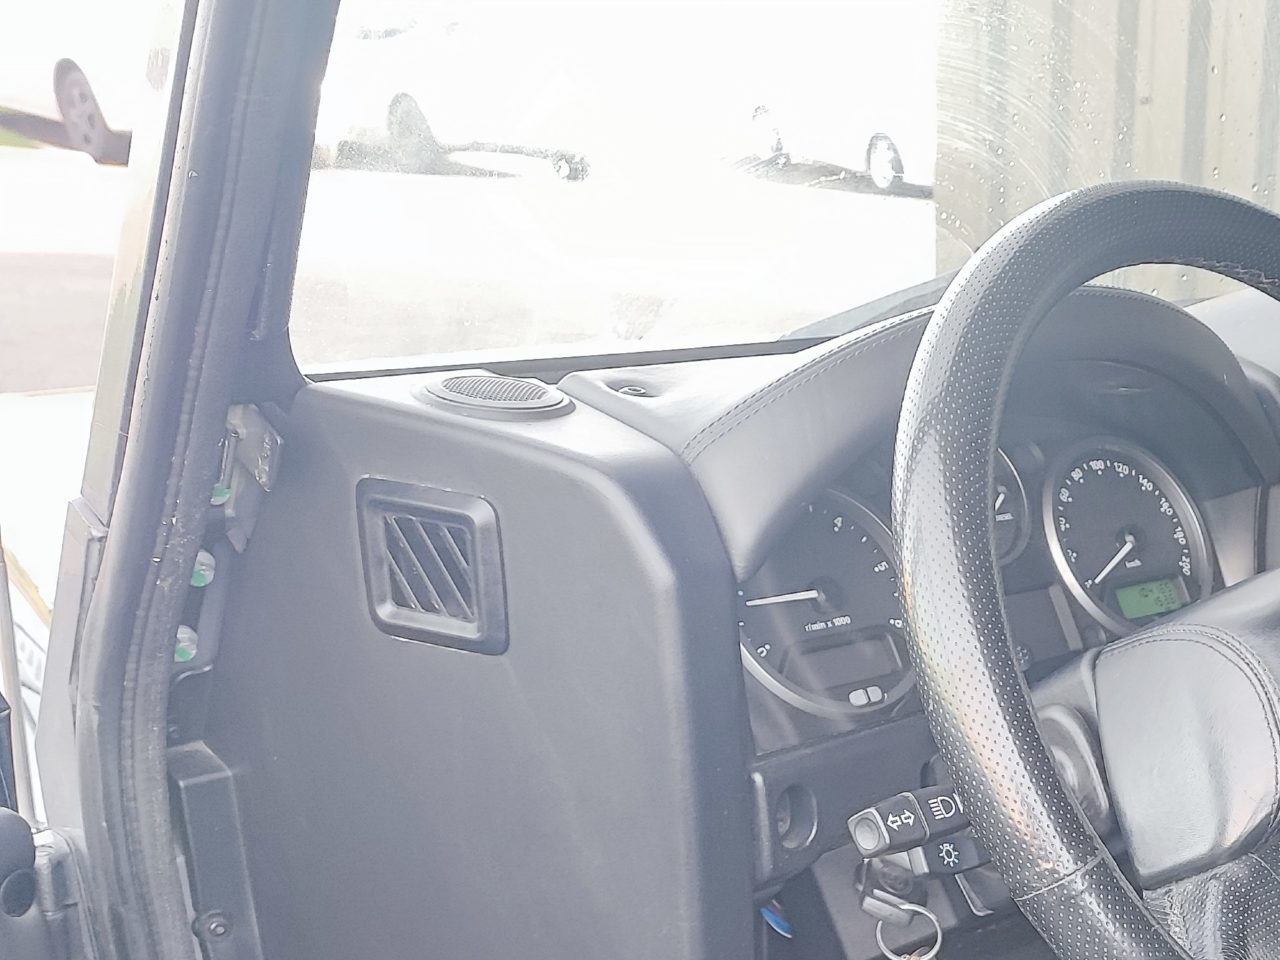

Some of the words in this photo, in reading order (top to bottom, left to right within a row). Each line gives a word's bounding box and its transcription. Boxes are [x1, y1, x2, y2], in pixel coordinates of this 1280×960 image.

[1089, 460, 1105, 470] 100
[1114, 462, 1129, 475] 120
[1138, 475, 1153, 491] 140
[1160, 498, 1174, 516] 160
[1181, 556, 1191, 576] 200
[833, 615, 851, 627] 1000
